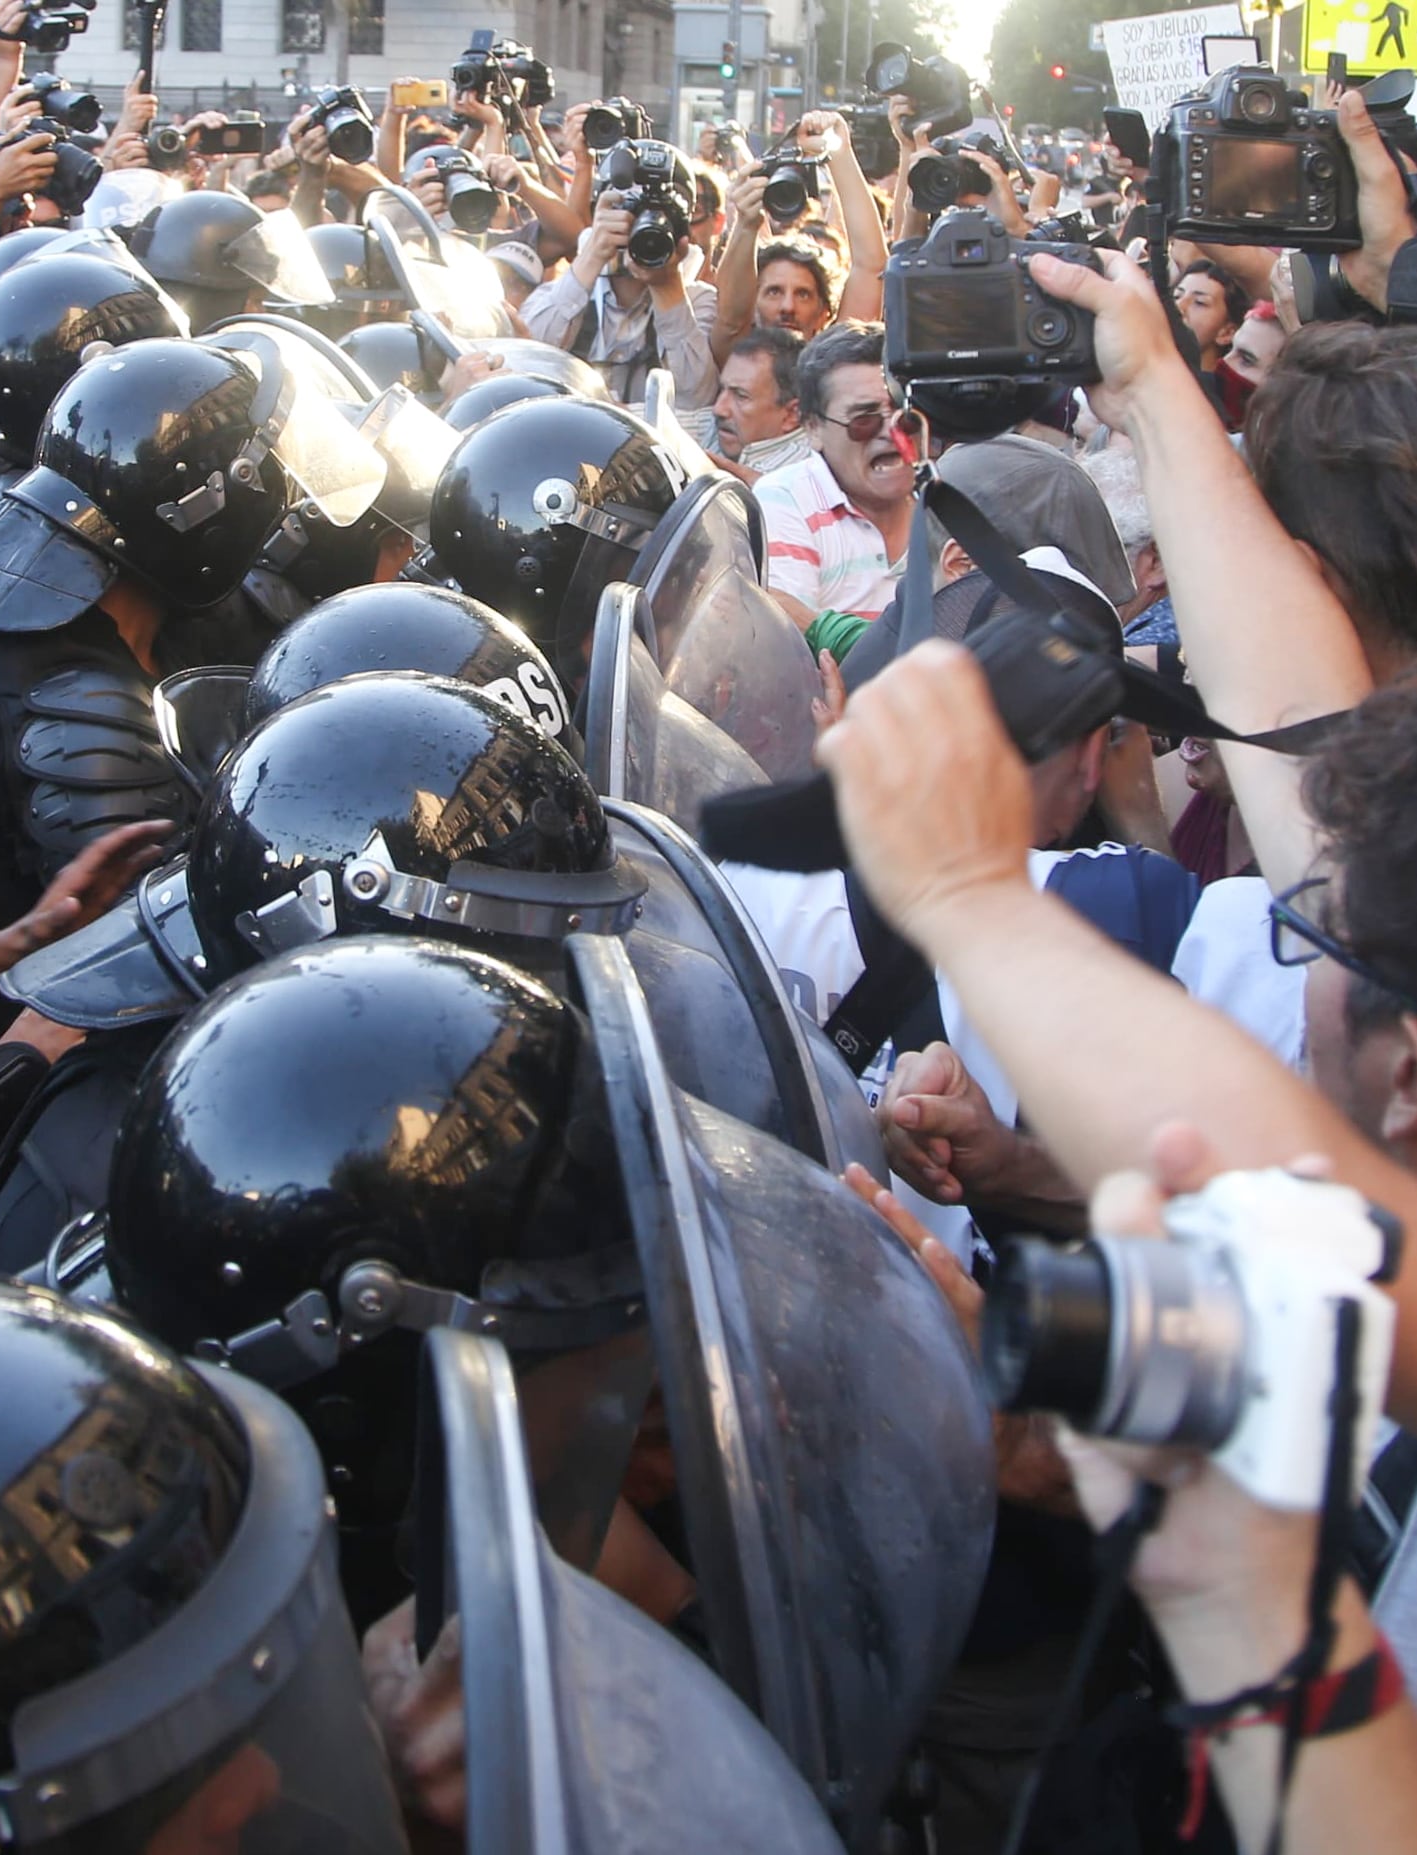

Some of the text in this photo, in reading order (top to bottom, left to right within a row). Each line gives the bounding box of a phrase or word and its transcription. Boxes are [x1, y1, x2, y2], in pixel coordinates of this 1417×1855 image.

[1122, 15, 1208, 43] SOY JUBILADO
[1135, 43, 1173, 63] COBRO
[1116, 64, 1159, 88] GRACIAS
[1172, 61, 1193, 80] VOS
[482, 660, 570, 738] PS
